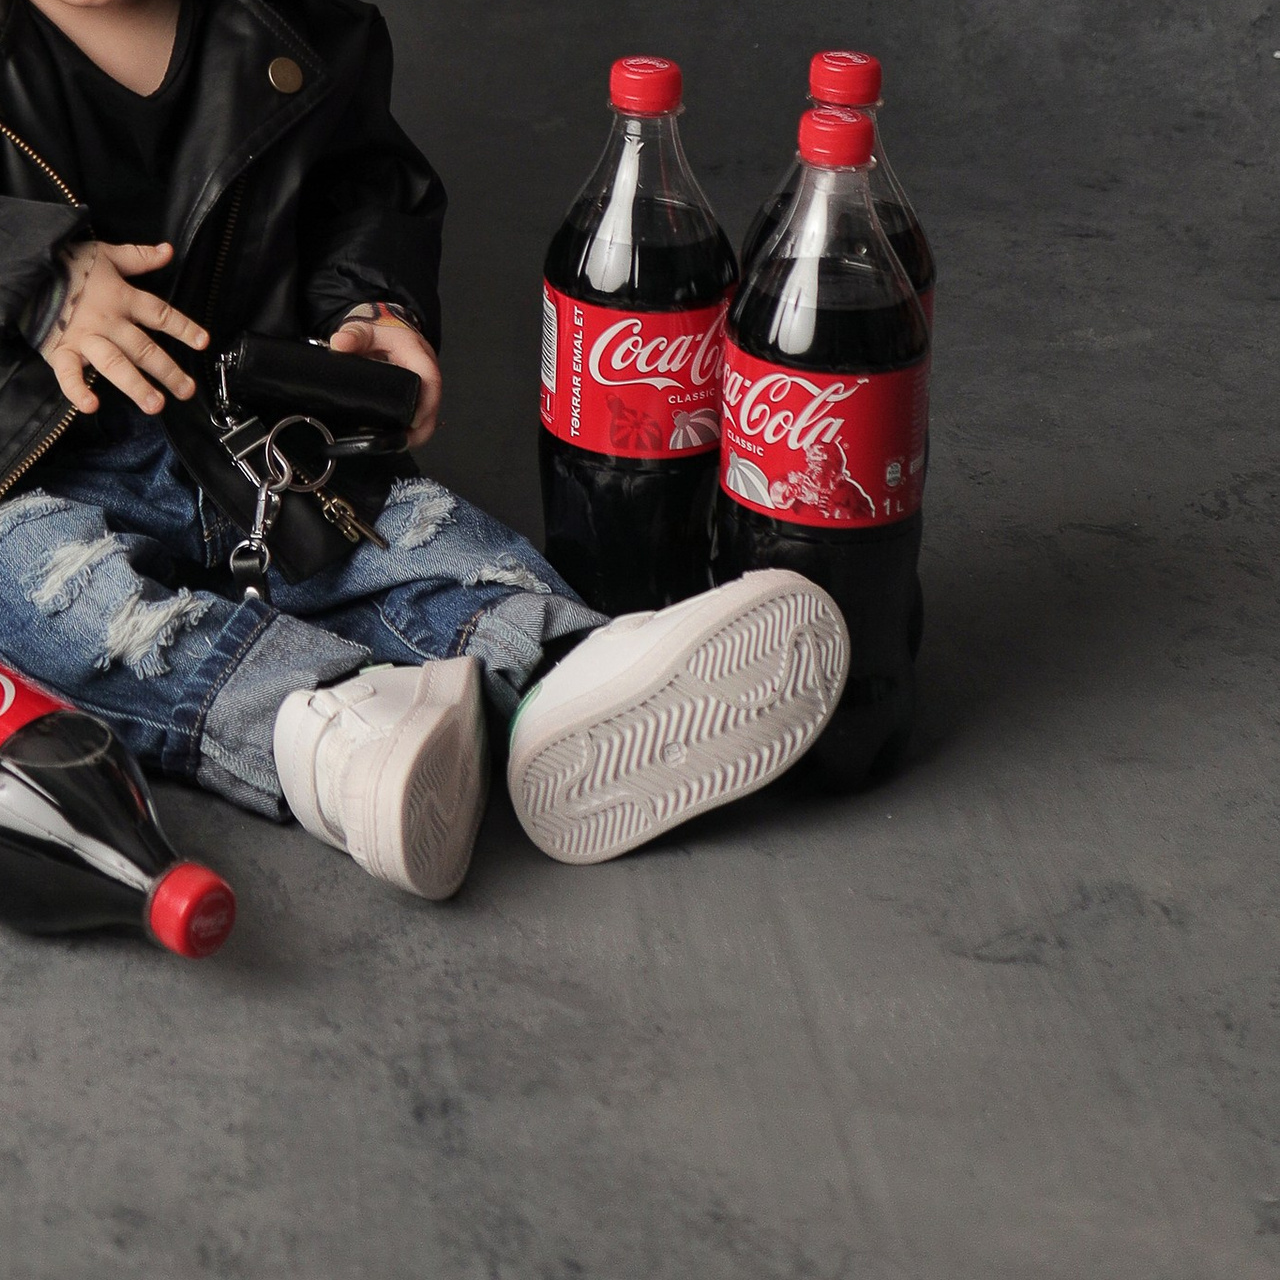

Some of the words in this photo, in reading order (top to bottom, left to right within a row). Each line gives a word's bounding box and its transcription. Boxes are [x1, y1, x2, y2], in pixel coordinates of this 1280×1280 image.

[574, 306, 585, 327] ET
[572, 330, 584, 373] EMAL
[667, 388, 716, 405] CLASSIC
[727, 428, 765, 457] CLASSIC
[882, 498, 891, 516] 1
